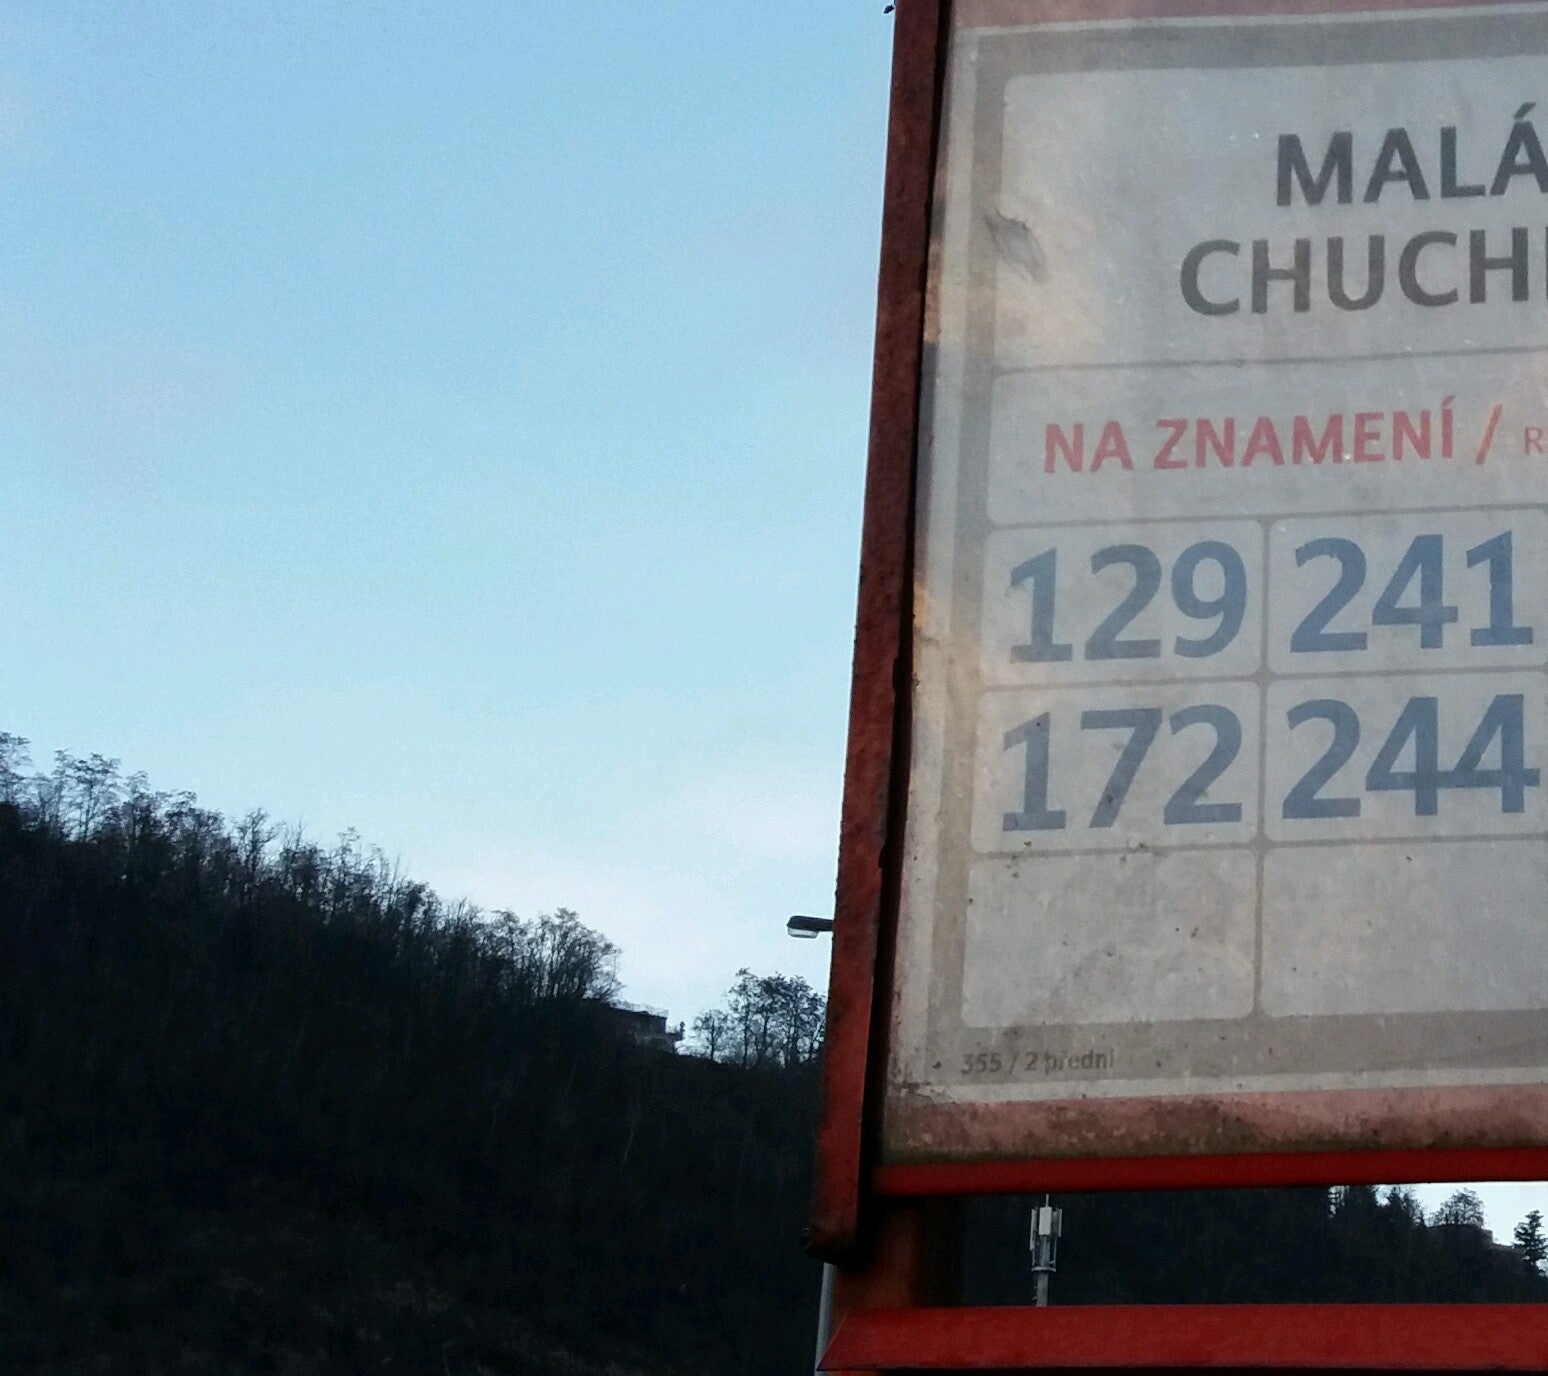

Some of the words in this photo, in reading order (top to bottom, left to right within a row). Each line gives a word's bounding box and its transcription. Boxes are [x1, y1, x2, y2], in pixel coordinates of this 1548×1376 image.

[1043, 420, 1134, 473] NA
[1153, 396, 1456, 470] ZNAMENÍ
[1477, 404, 1503, 464] /
[1009, 539, 1248, 663] 129
[1291, 531, 1535, 653] 241
[1001, 704, 1243, 832] 172
[1283, 693, 1540, 818] 244
[961, 1052, 1002, 1074] 355
[1025, 1051, 1037, 1071] 2
